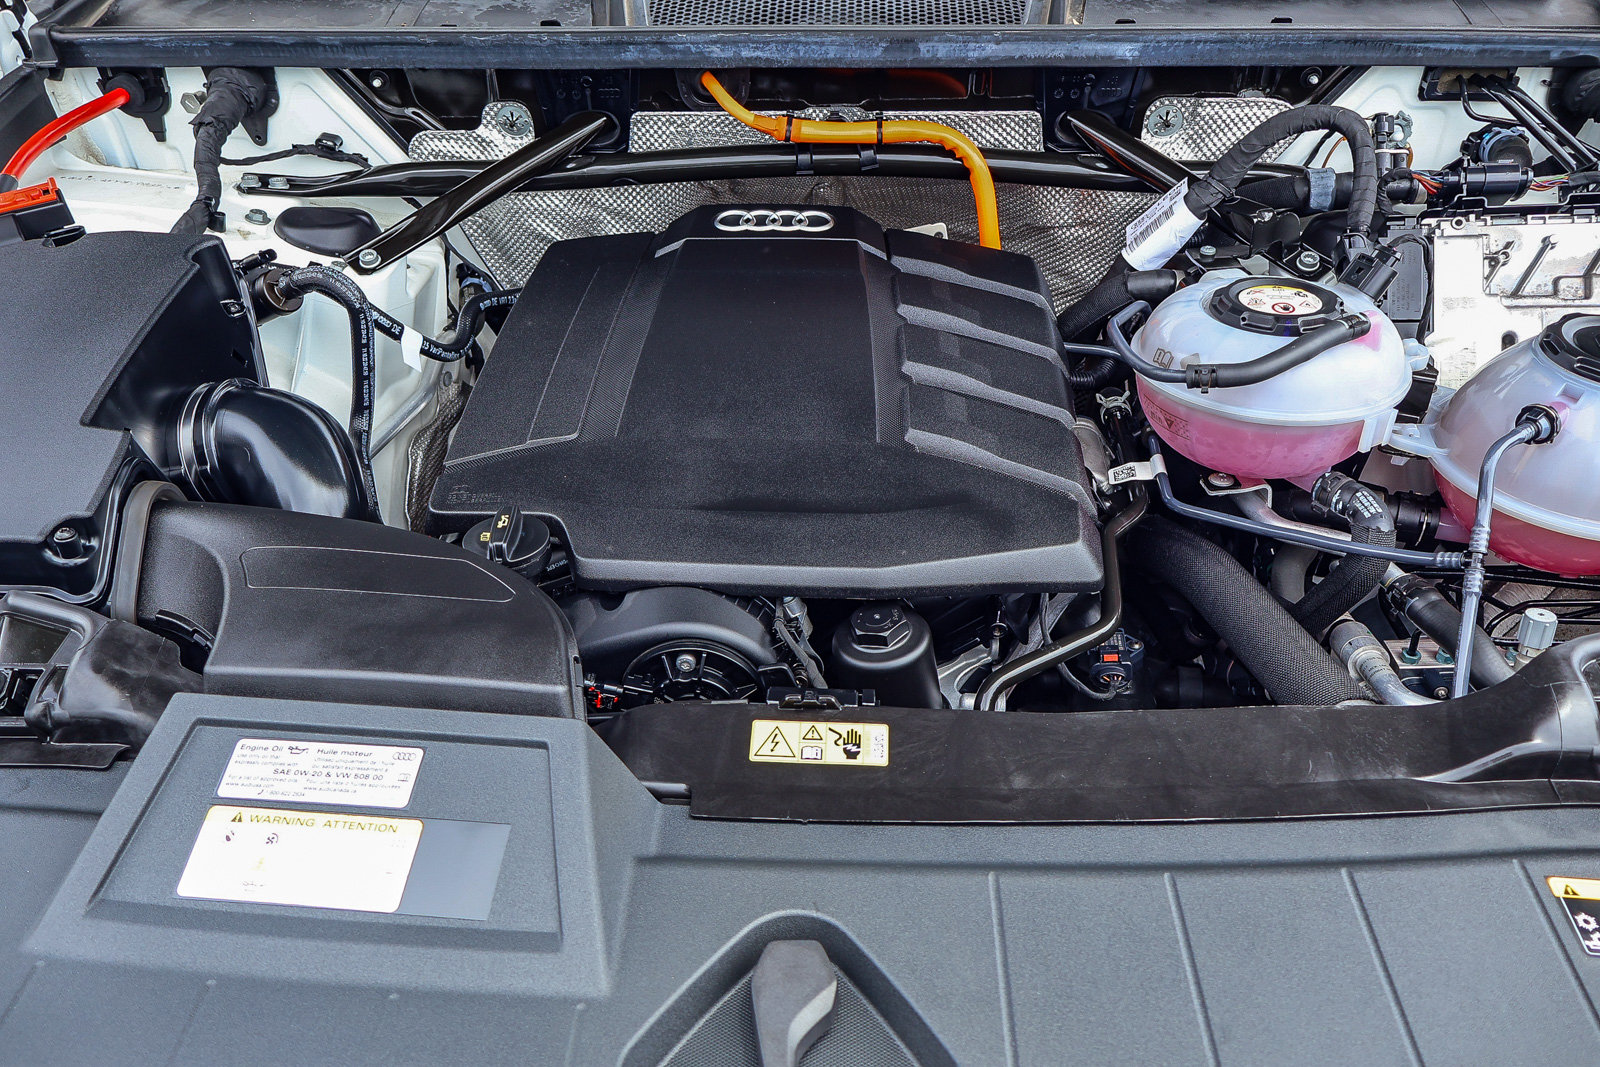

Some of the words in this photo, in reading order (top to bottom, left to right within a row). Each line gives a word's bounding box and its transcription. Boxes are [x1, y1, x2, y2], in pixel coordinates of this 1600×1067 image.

[391, 323, 402, 335] DE
[240, 744, 269, 752] Engine
[325, 770, 331, 778] &
[336, 771, 352, 779] VW
[250, 814, 316, 827] WARNING
[322, 819, 399, 833] ATTENTION
